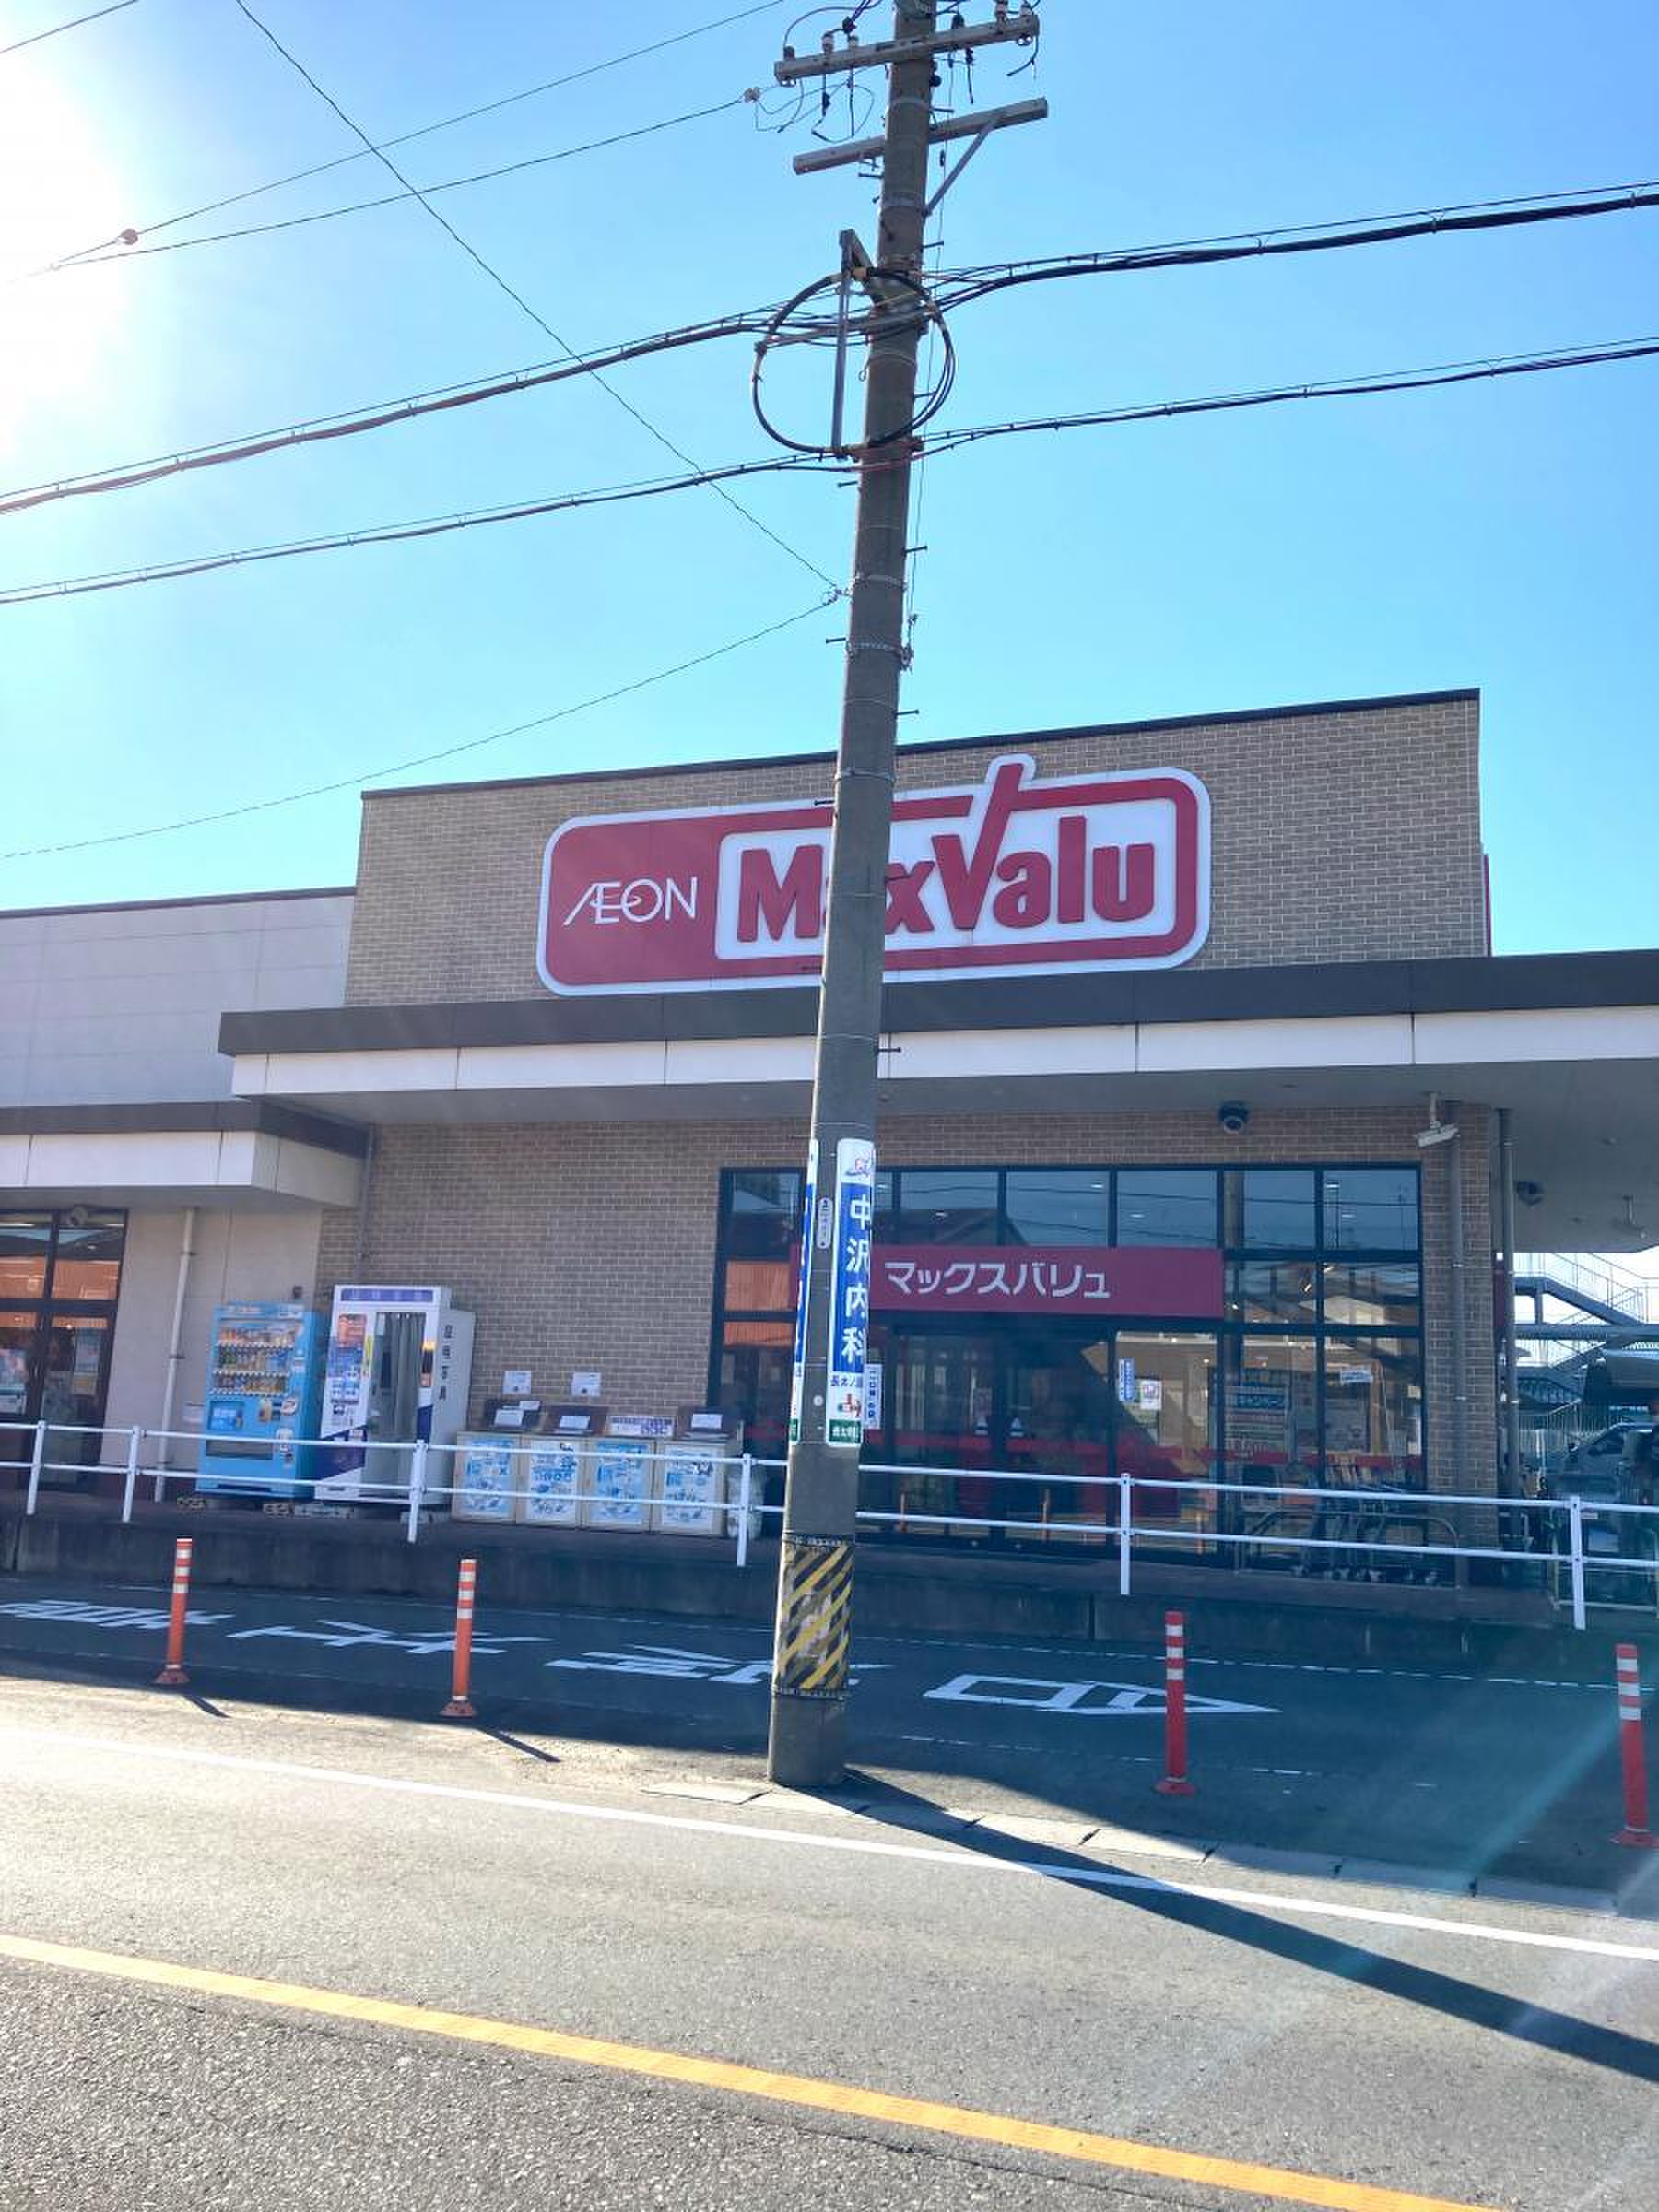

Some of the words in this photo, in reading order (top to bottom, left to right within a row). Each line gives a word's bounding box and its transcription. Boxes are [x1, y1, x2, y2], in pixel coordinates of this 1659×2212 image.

[736, 762, 1156, 943] MxValu
[841, 1194, 871, 1364] 中沢内科
[884, 1262, 1111, 1299] マックスバリュ
